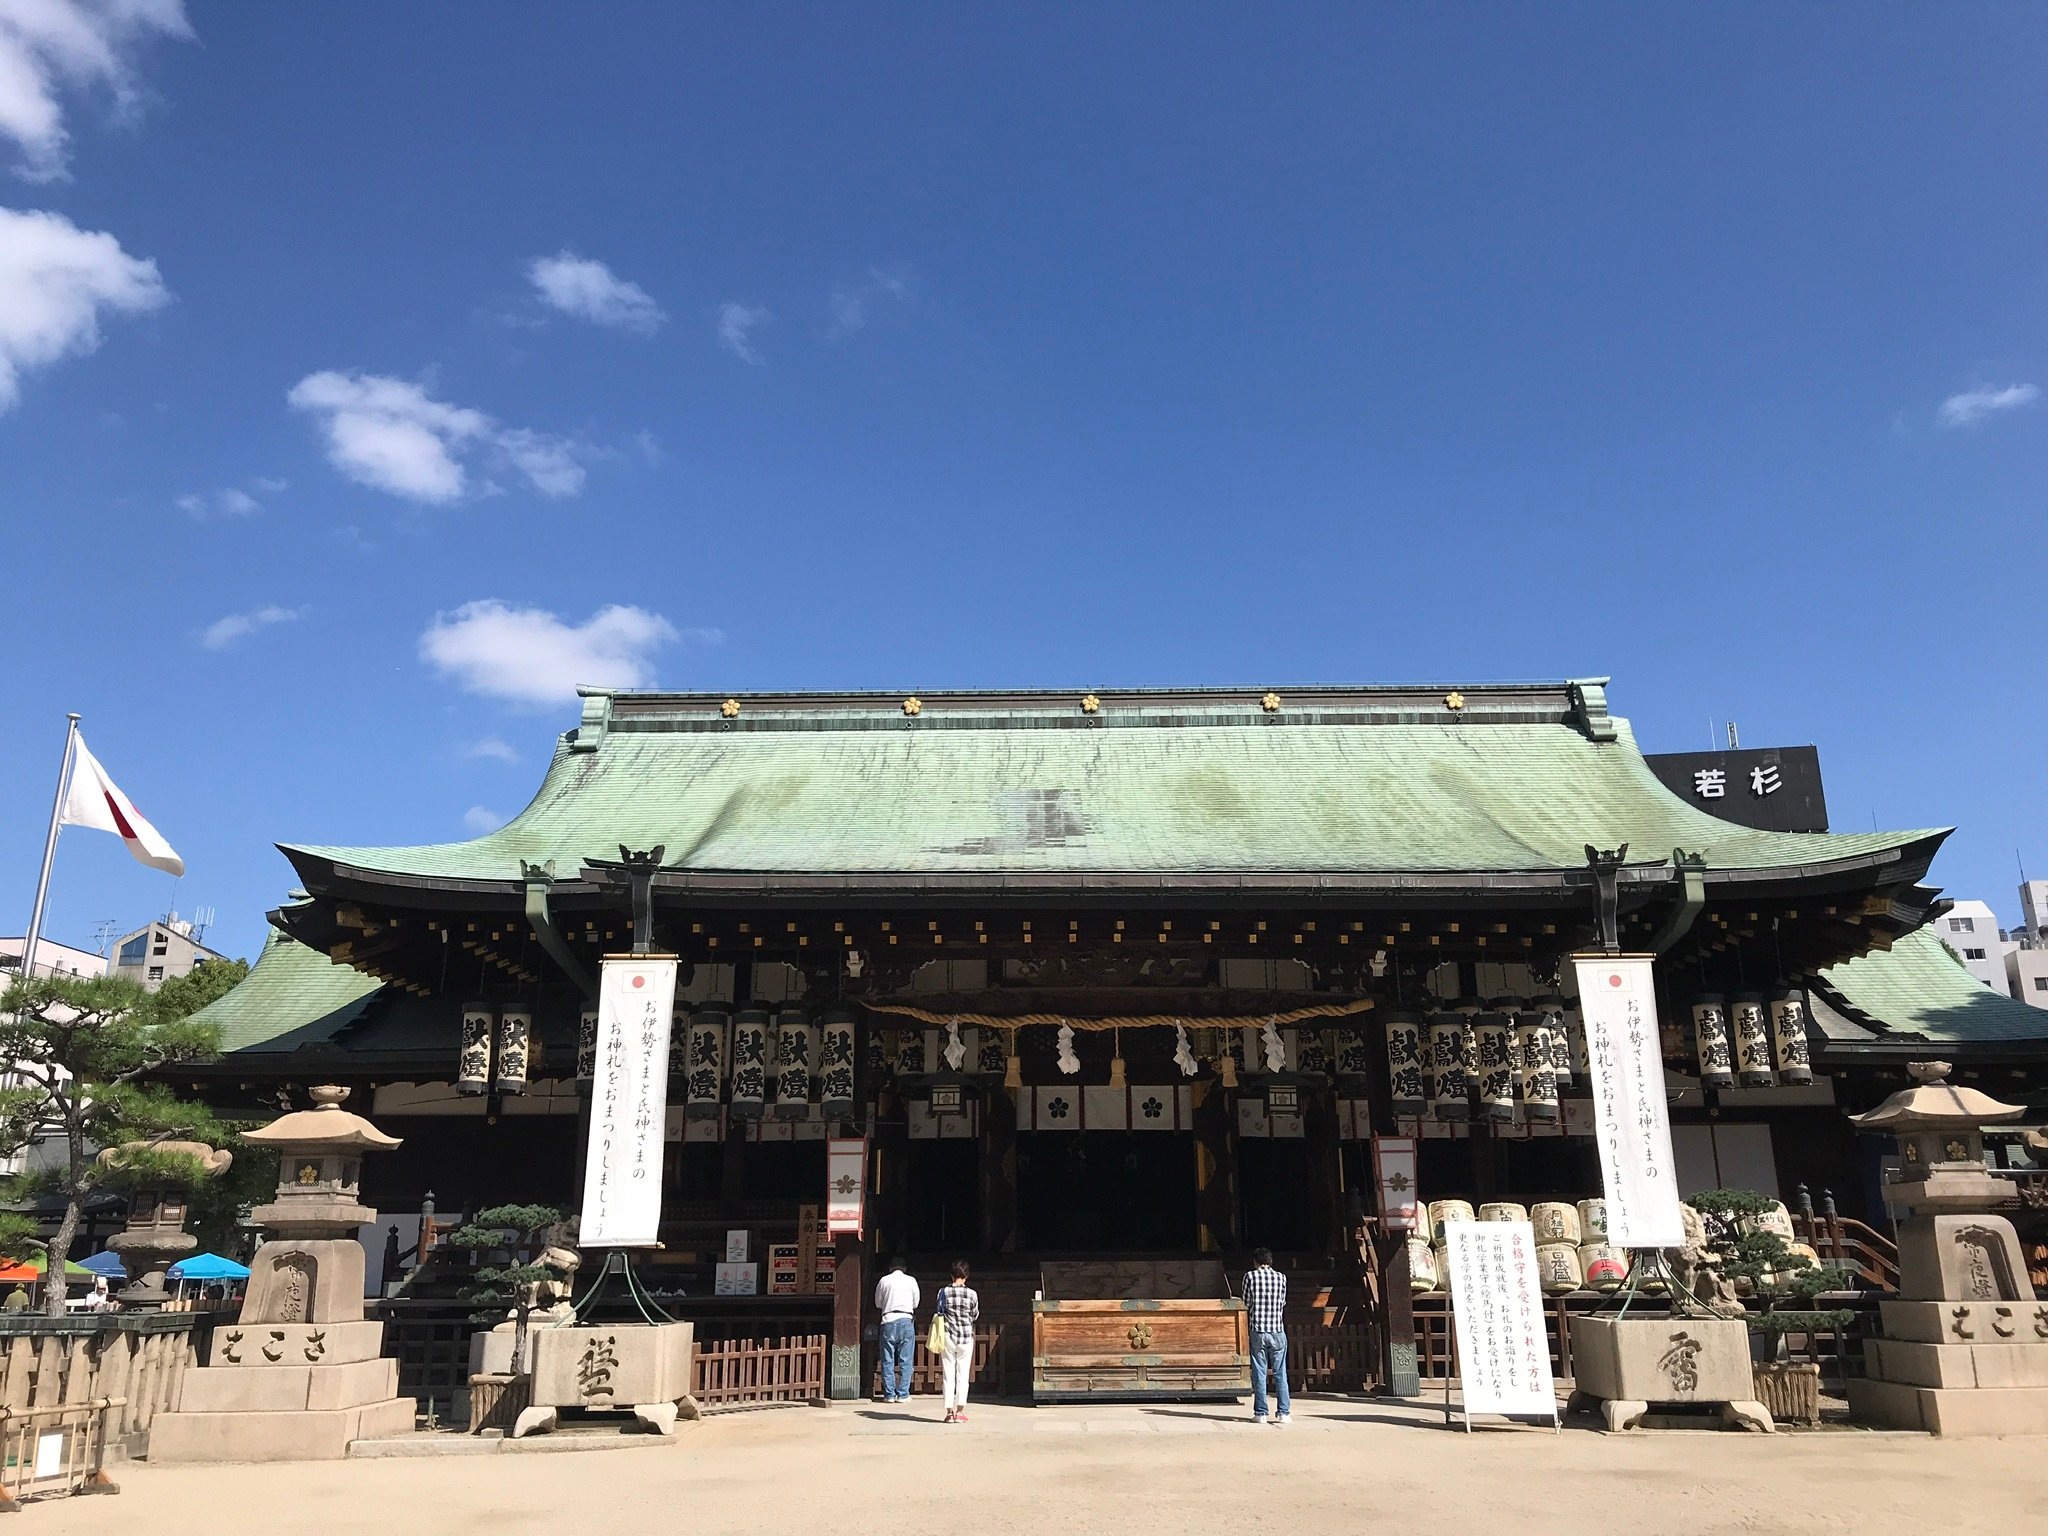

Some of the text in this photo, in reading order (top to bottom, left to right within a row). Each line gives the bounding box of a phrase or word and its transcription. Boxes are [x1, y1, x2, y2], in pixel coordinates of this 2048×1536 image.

[1694, 765, 1783, 798] 若杉
[594, 1022, 622, 1237] お神札をおまつりしましょう
[632, 1000, 657, 1179] お伊勢さまと氏神さまの
[1595, 1021, 1629, 1236] お神札をおまつりしましょう
[1627, 999, 1657, 1178] お伊勢さまと氏神さまの
[1551, 1210, 1565, 1238] 月桂冠
[1551, 1252, 1570, 1281] 日本盛
[1511, 1233, 1541, 1393] 合格守を受けられた方は
